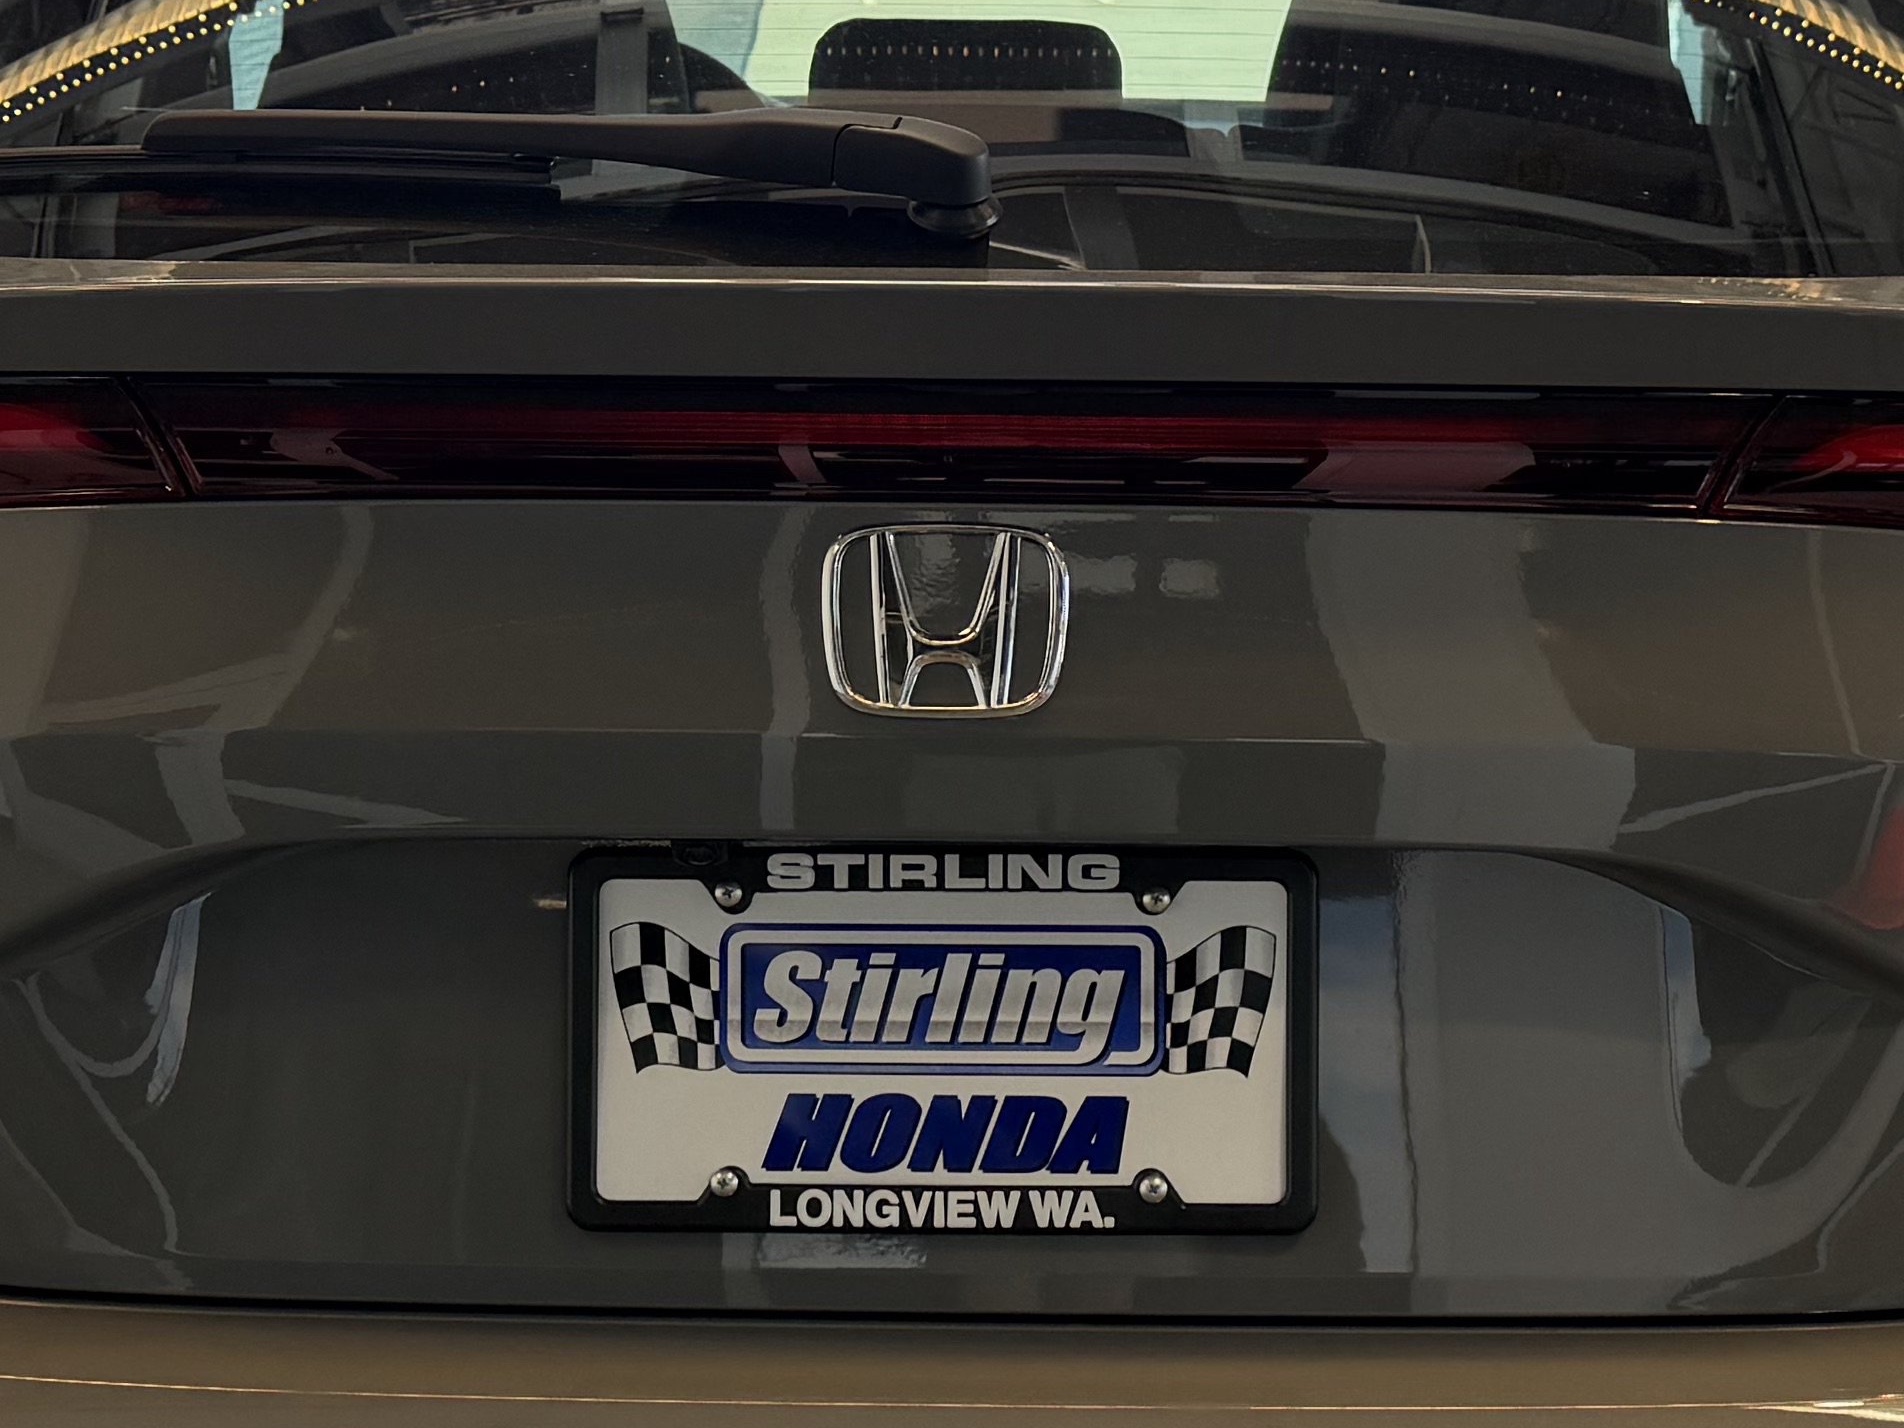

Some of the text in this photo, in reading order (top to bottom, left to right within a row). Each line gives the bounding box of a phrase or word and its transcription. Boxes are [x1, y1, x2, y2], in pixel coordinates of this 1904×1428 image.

[766, 852, 1121, 890] STIRLING
[752, 949, 1125, 1064] Stirling
[761, 1092, 1130, 1174] HONDA
[768, 1188, 1116, 1229] LONGVIEW WA.
